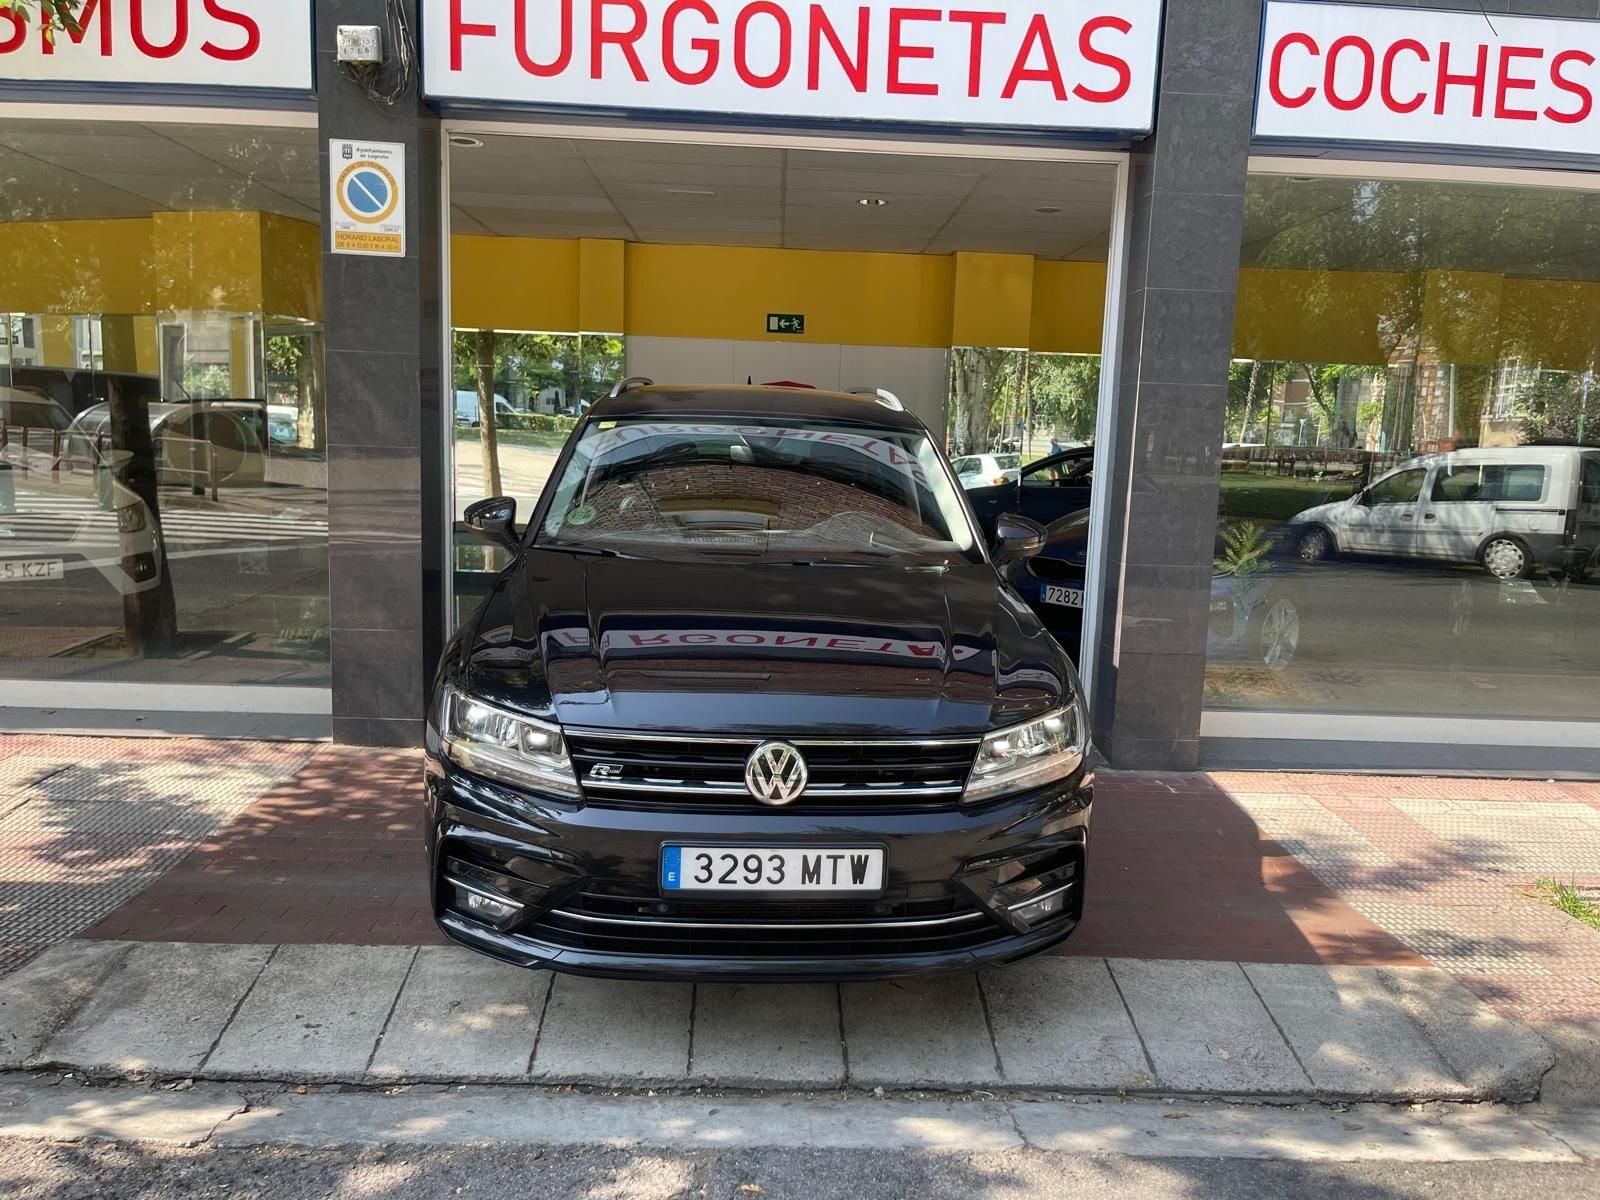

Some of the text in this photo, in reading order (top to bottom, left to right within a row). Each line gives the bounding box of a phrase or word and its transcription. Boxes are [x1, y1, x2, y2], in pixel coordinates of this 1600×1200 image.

[450, 0, 1132, 103] FURGONETAS
[1269, 32, 1594, 124] COCHES
[337, 233, 399, 243] HORARIO LABORAL
[22, 562, 57, 577] KZF
[1048, 587, 1079, 605] 7282
[668, 852, 870, 886] E 3293 MTW
